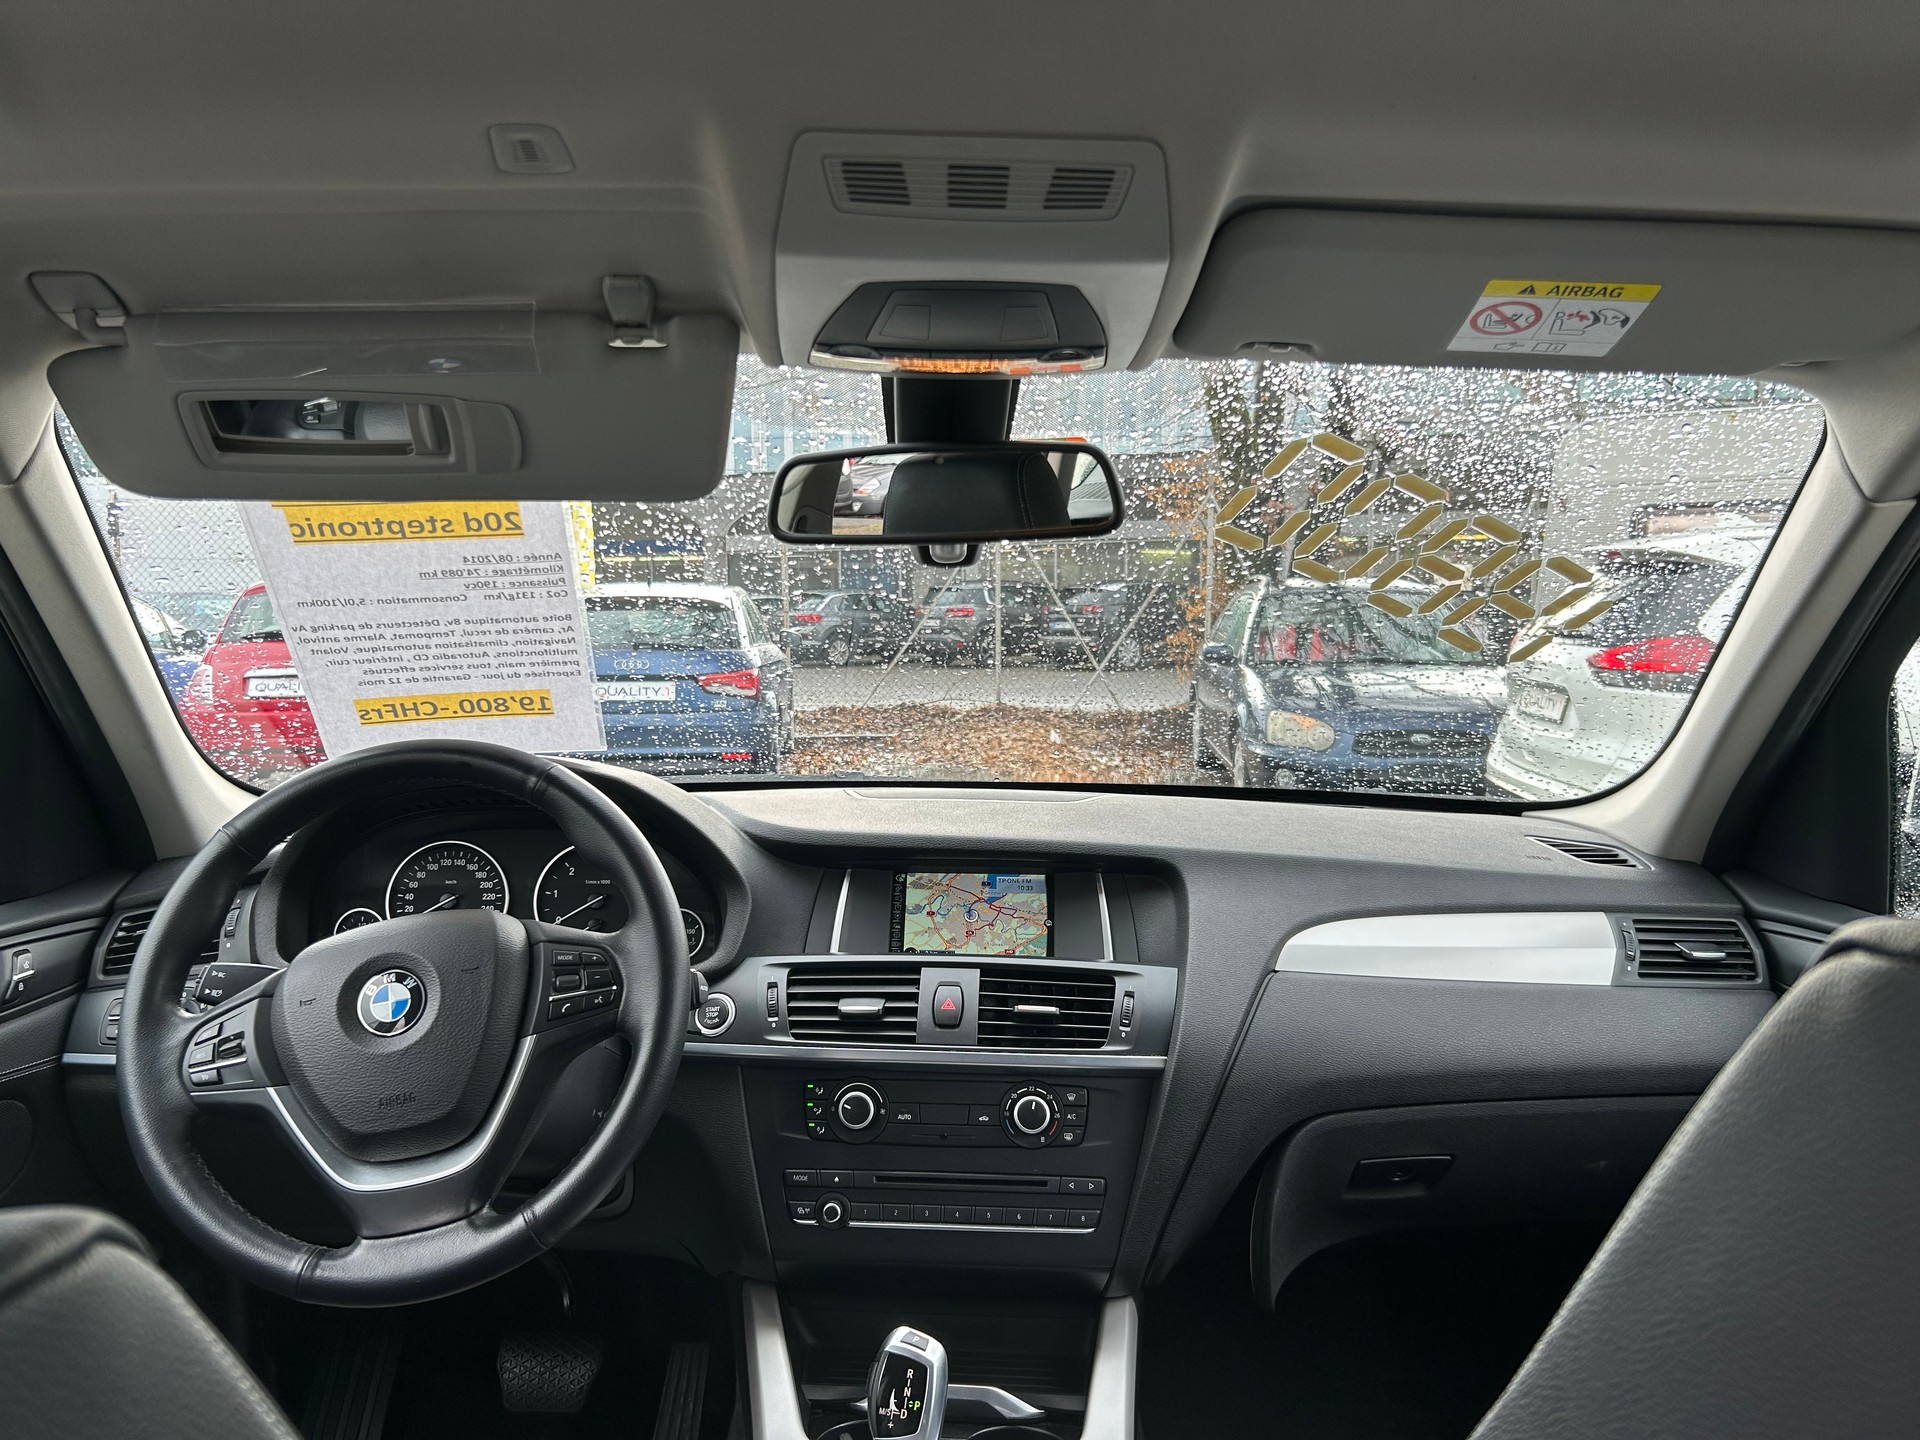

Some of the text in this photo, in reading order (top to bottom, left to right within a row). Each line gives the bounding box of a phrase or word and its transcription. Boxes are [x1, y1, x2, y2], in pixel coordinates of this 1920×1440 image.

[1546, 285, 1625, 299] AIRBAG
[466, 863, 479, 871] 160
[569, 867, 575, 876] 2
[553, 889, 558, 898] 1
[404, 905, 414, 913] 20
[365, 972, 418, 997] BMW
[897, 1113, 912, 1121] AUTO
[793, 1174, 809, 1182] MODE
[912, 1335, 920, 1343] P
[906, 1368, 914, 1379] R
[903, 1386, 911, 1398] N
[914, 1400, 921, 1411] P
[900, 1408, 908, 1419] D
